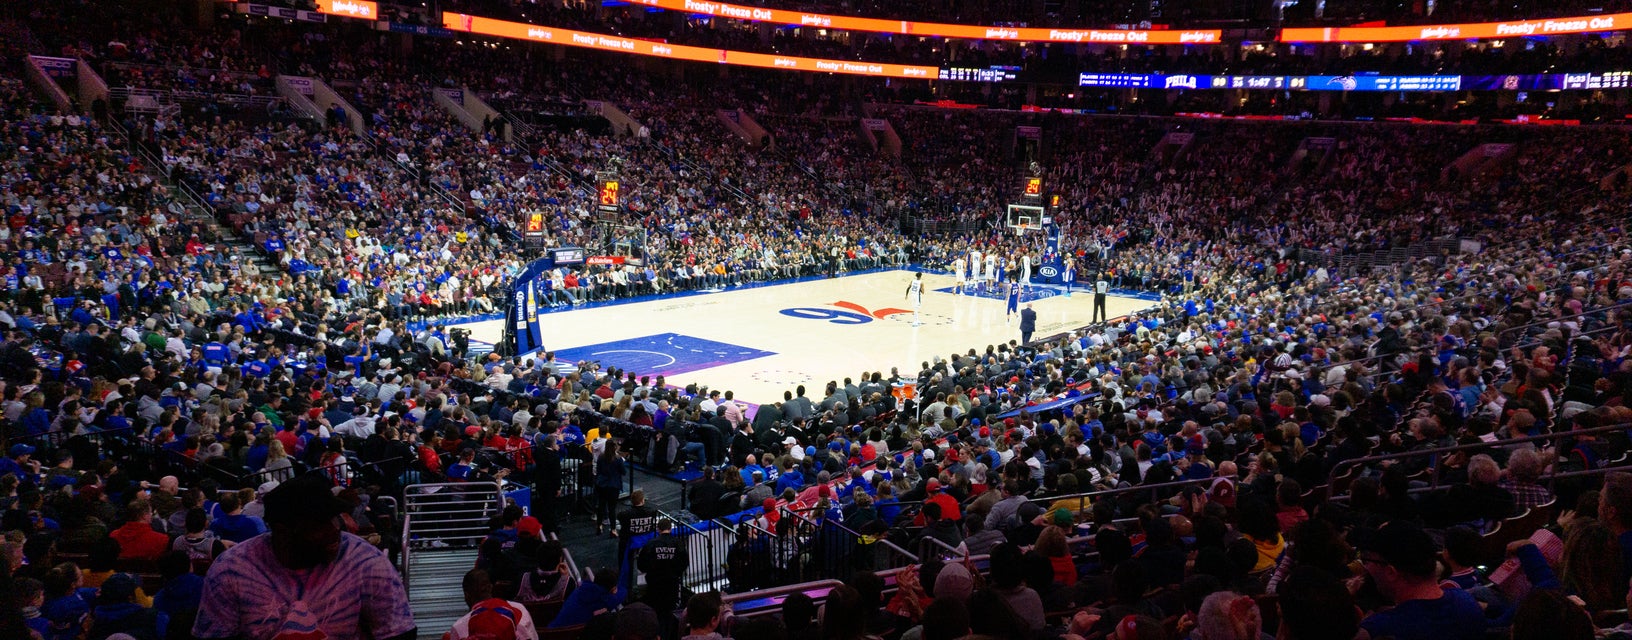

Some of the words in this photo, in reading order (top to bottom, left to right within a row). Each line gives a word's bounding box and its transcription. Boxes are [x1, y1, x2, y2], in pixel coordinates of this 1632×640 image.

[684, 0, 713, 13] Frosty
[720, 4, 751, 18] Freeze
[753, 9, 772, 20] Out
[1496, 23, 1536, 34] Frosty
[1544, 20, 1588, 31] Freeze
[1590, 17, 1614, 28] Out
[1050, 31, 1082, 41] Frosty
[1090, 32, 1124, 40] Freeze
[1126, 32, 1148, 41] Out
[573, 34, 596, 46] Frosty
[598, 37, 620, 48] Freeze
[622, 40, 634, 50] Out
[816, 62, 838, 72] Frosty
[844, 64, 868, 72] Freeze
[1165, 75, 1196, 88] PHILA
[1248, 77, 1270, 87] 1:47
[1028, 184, 1038, 193] 24
[603, 189, 616, 204] 24
[516, 290, 524, 321] Corona
[630, 516, 652, 526] EVENT
[630, 525, 652, 533] STAFF
